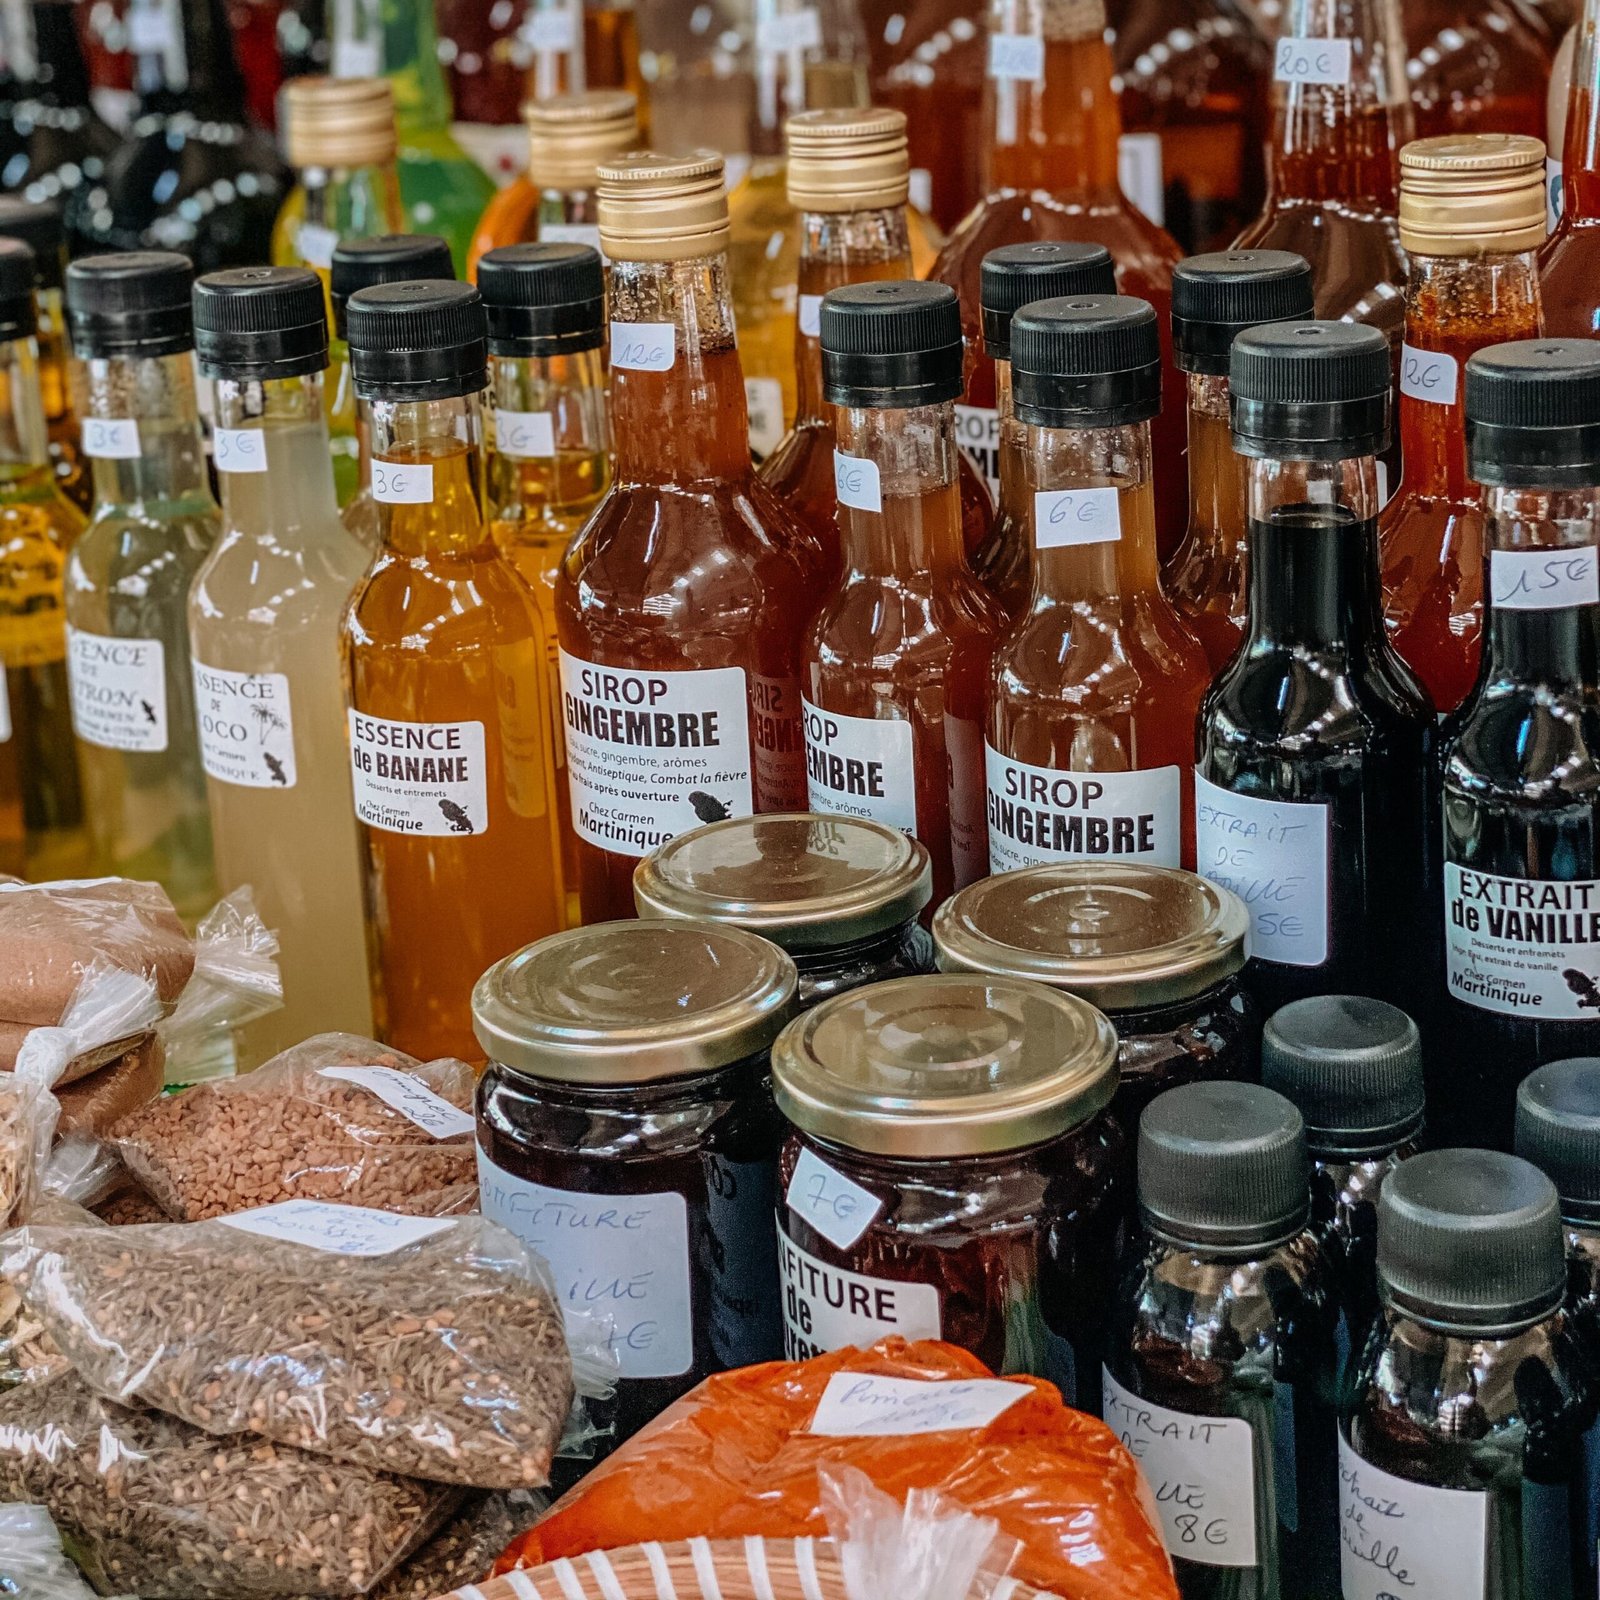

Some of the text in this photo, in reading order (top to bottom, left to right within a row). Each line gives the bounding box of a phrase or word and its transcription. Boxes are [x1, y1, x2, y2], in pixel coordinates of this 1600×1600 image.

[1278, 45, 1331, 75] 20€
[617, 343, 665, 365] 12€
[375, 469, 409, 494] 3€
[1049, 496, 1099, 524] 6€
[1496, 558, 1591, 602] 15€
[581, 668, 669, 706] SIROP
[355, 717, 461, 751] ESSENCE
[565, 691, 720, 748] GINGEMBRE
[354, 745, 469, 783] de BANANE
[588, 761, 647, 785] Antiseptique,
[650, 773, 697, 784] Combat
[700, 773, 711, 784] la
[715, 770, 748, 783] fièvre
[601, 750, 661, 769] gingembre,
[663, 757, 707, 769] arômes
[806, 741, 885, 798] EMBRE
[365, 778, 393, 796] Desserts
[403, 788, 447, 799] entremets
[595, 782, 618, 798] après
[621, 789, 680, 802] ouverture
[1005, 767, 1104, 809] SIROP
[358, 803, 424, 832] Martinique
[589, 801, 655, 825] Chez Carmen
[835, 801, 872, 817] arômes
[988, 787, 1155, 854] GINGEMBRE
[579, 807, 674, 849] Martinique
[1460, 870, 1595, 910] EXTRAIT
[1452, 898, 1600, 944] de VANILLE
[1471, 938, 1505, 953] Desserts
[1518, 948, 1565, 958] entremets
[1485, 956, 1512, 967] extrait
[1514, 960, 1525, 968] de
[1527, 962, 1559, 972] vanille
[1452, 971, 1542, 1007] Martinique
[806, 1173, 858, 1220] 7€
[786, 1282, 813, 1336] de
[1174, 1512, 1228, 1545] 8€
